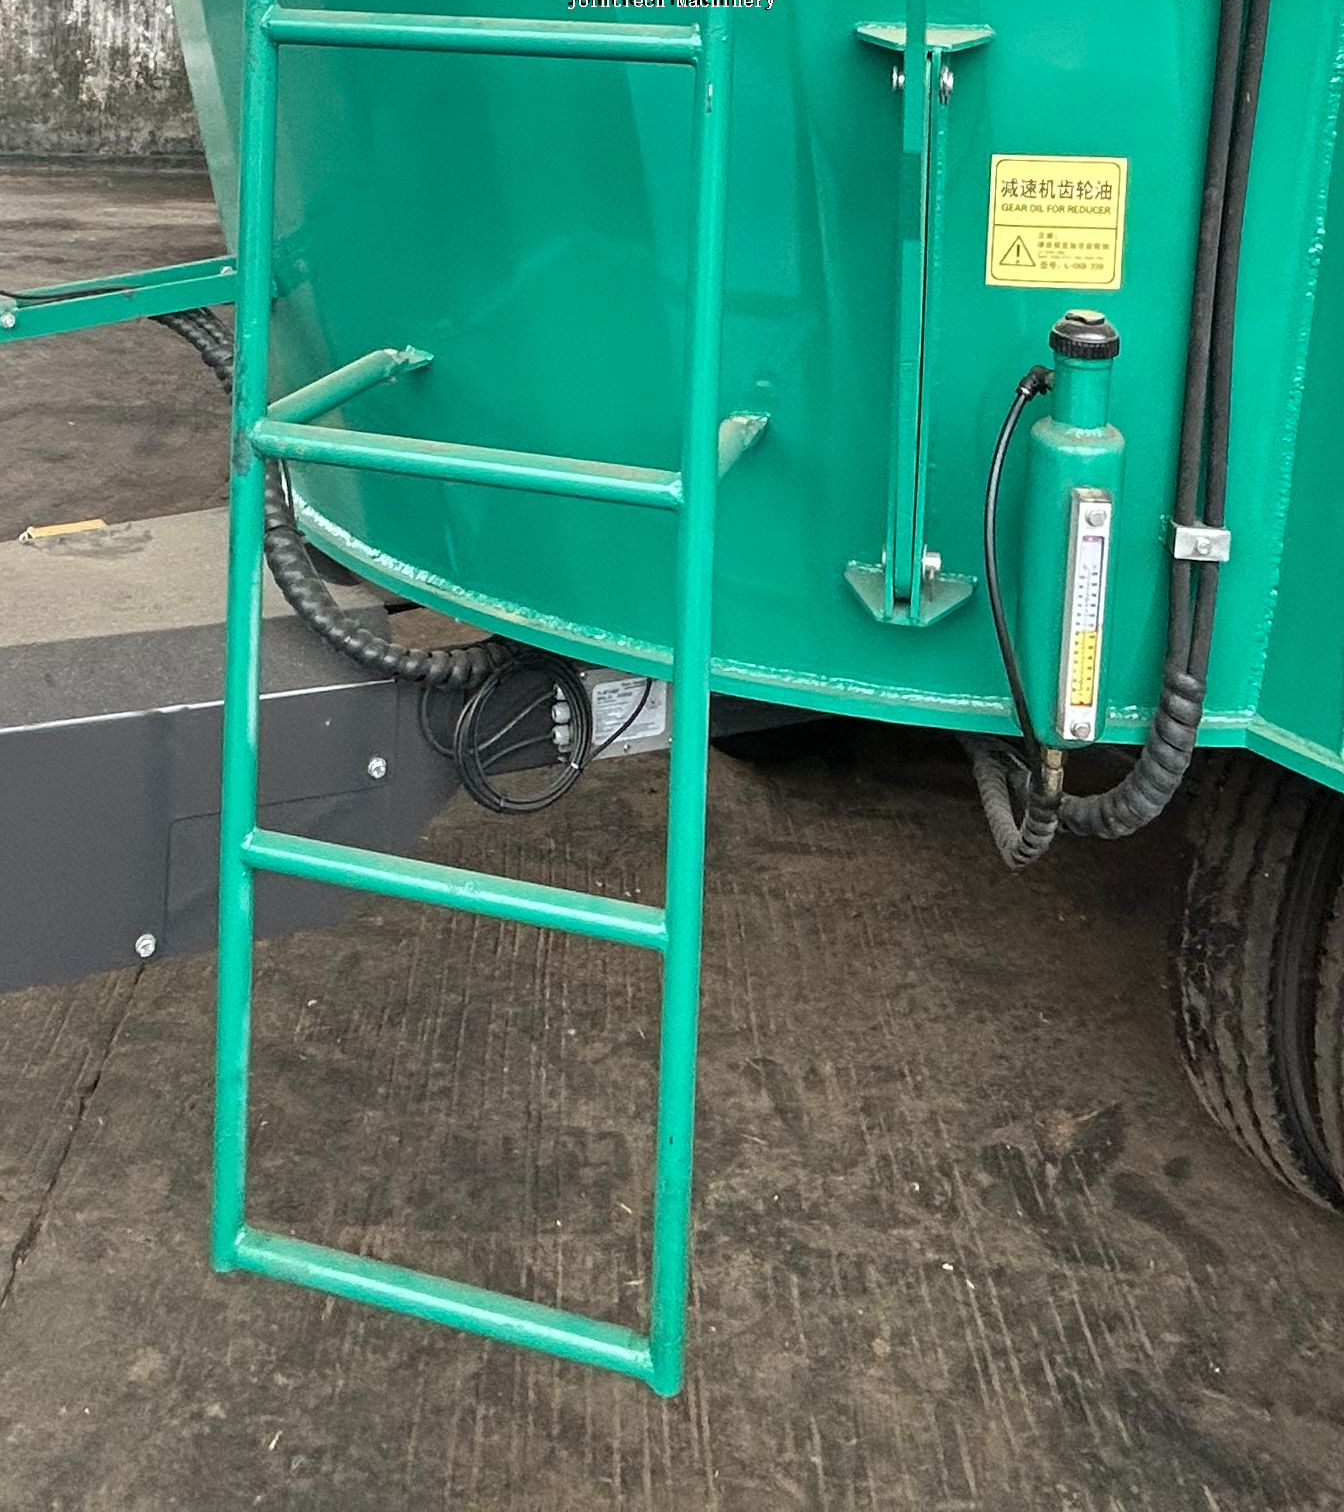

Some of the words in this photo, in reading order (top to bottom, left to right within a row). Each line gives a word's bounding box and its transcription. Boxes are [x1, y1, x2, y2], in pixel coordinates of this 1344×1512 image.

[1000, 178, 1113, 201] 减速机齿轮油
[1001, 203, 1027, 212] GEAR
[1029, 204, 1044, 213] OIL
[1046, 204, 1065, 213] FOR
[1067, 205, 1111, 215] REDUCER
